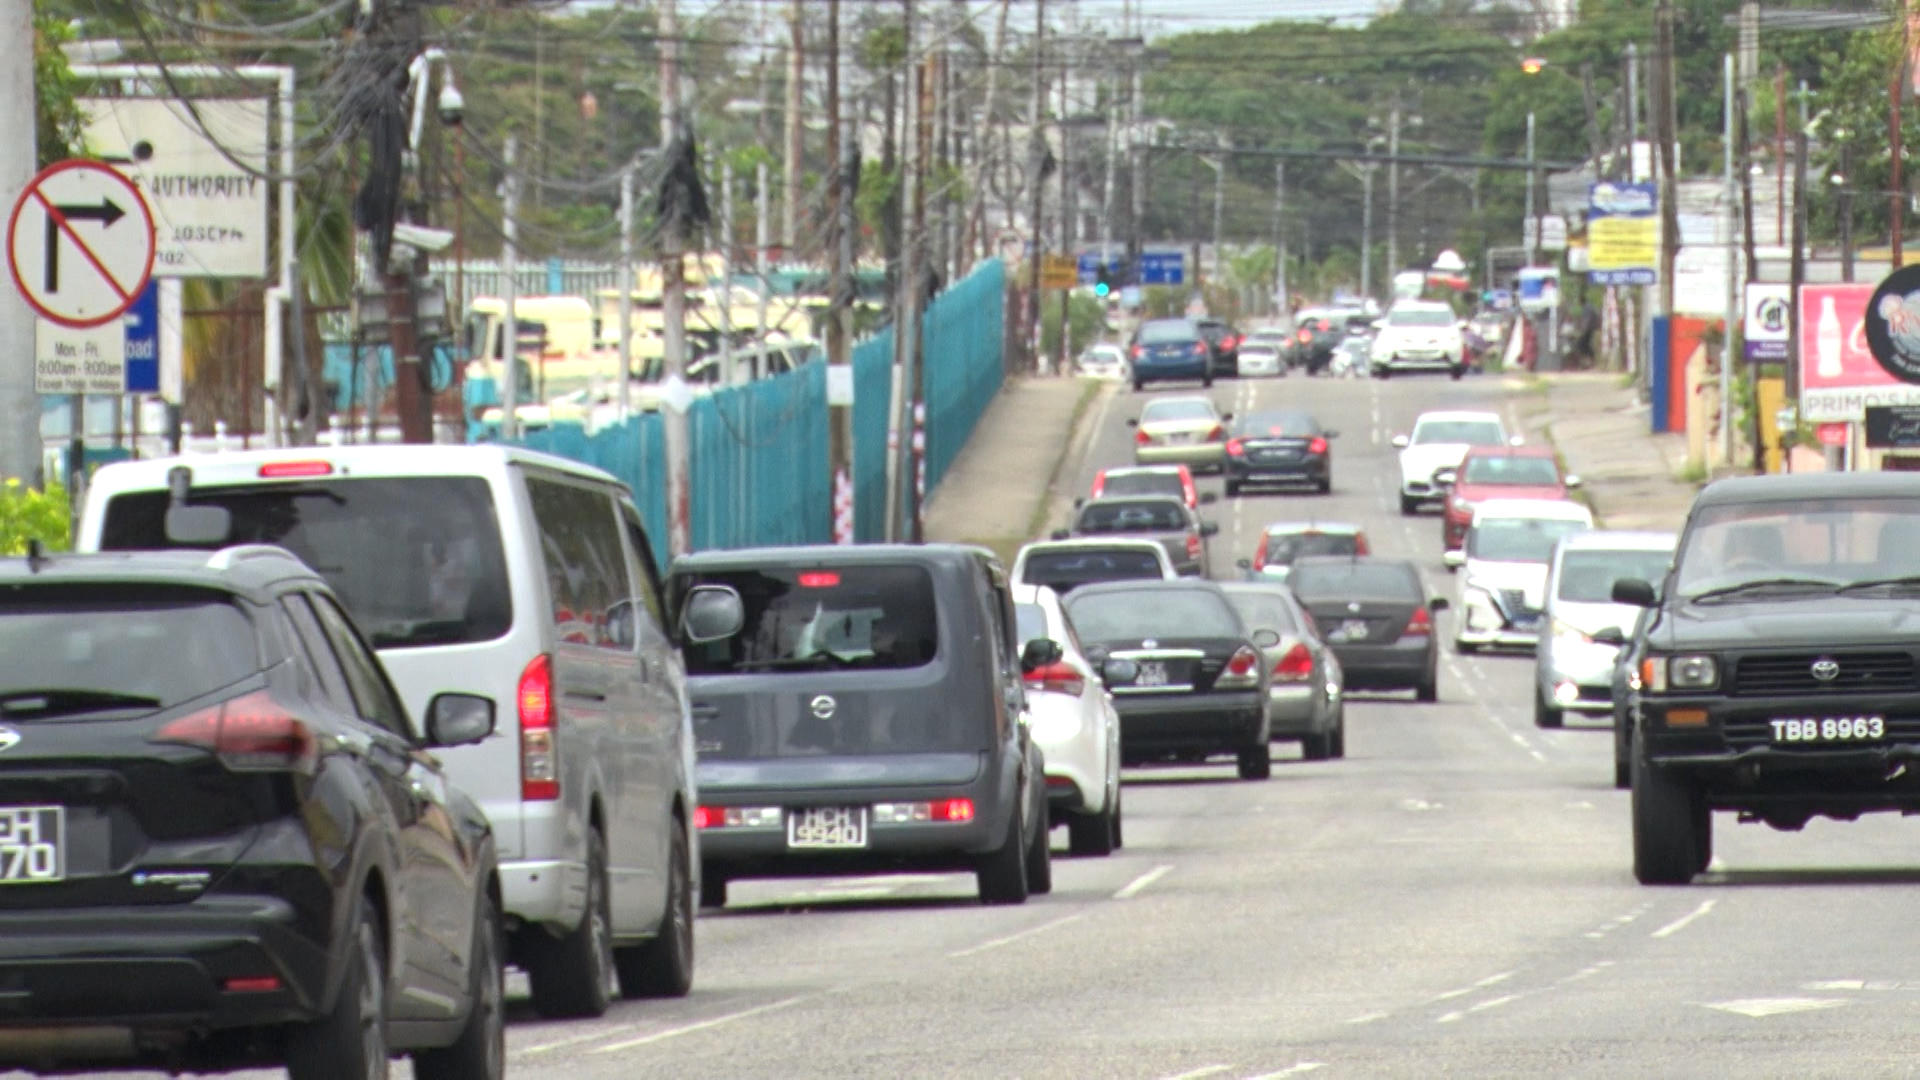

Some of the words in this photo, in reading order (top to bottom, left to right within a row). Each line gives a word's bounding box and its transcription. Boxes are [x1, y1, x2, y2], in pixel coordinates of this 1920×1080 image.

[152, 175, 256, 198] AUTHORITY
[125, 337, 153, 358] oad
[770, 720, 817, 741] TBB
[822, 717, 885, 739] 8963
[0, 844, 56, 879] 70
